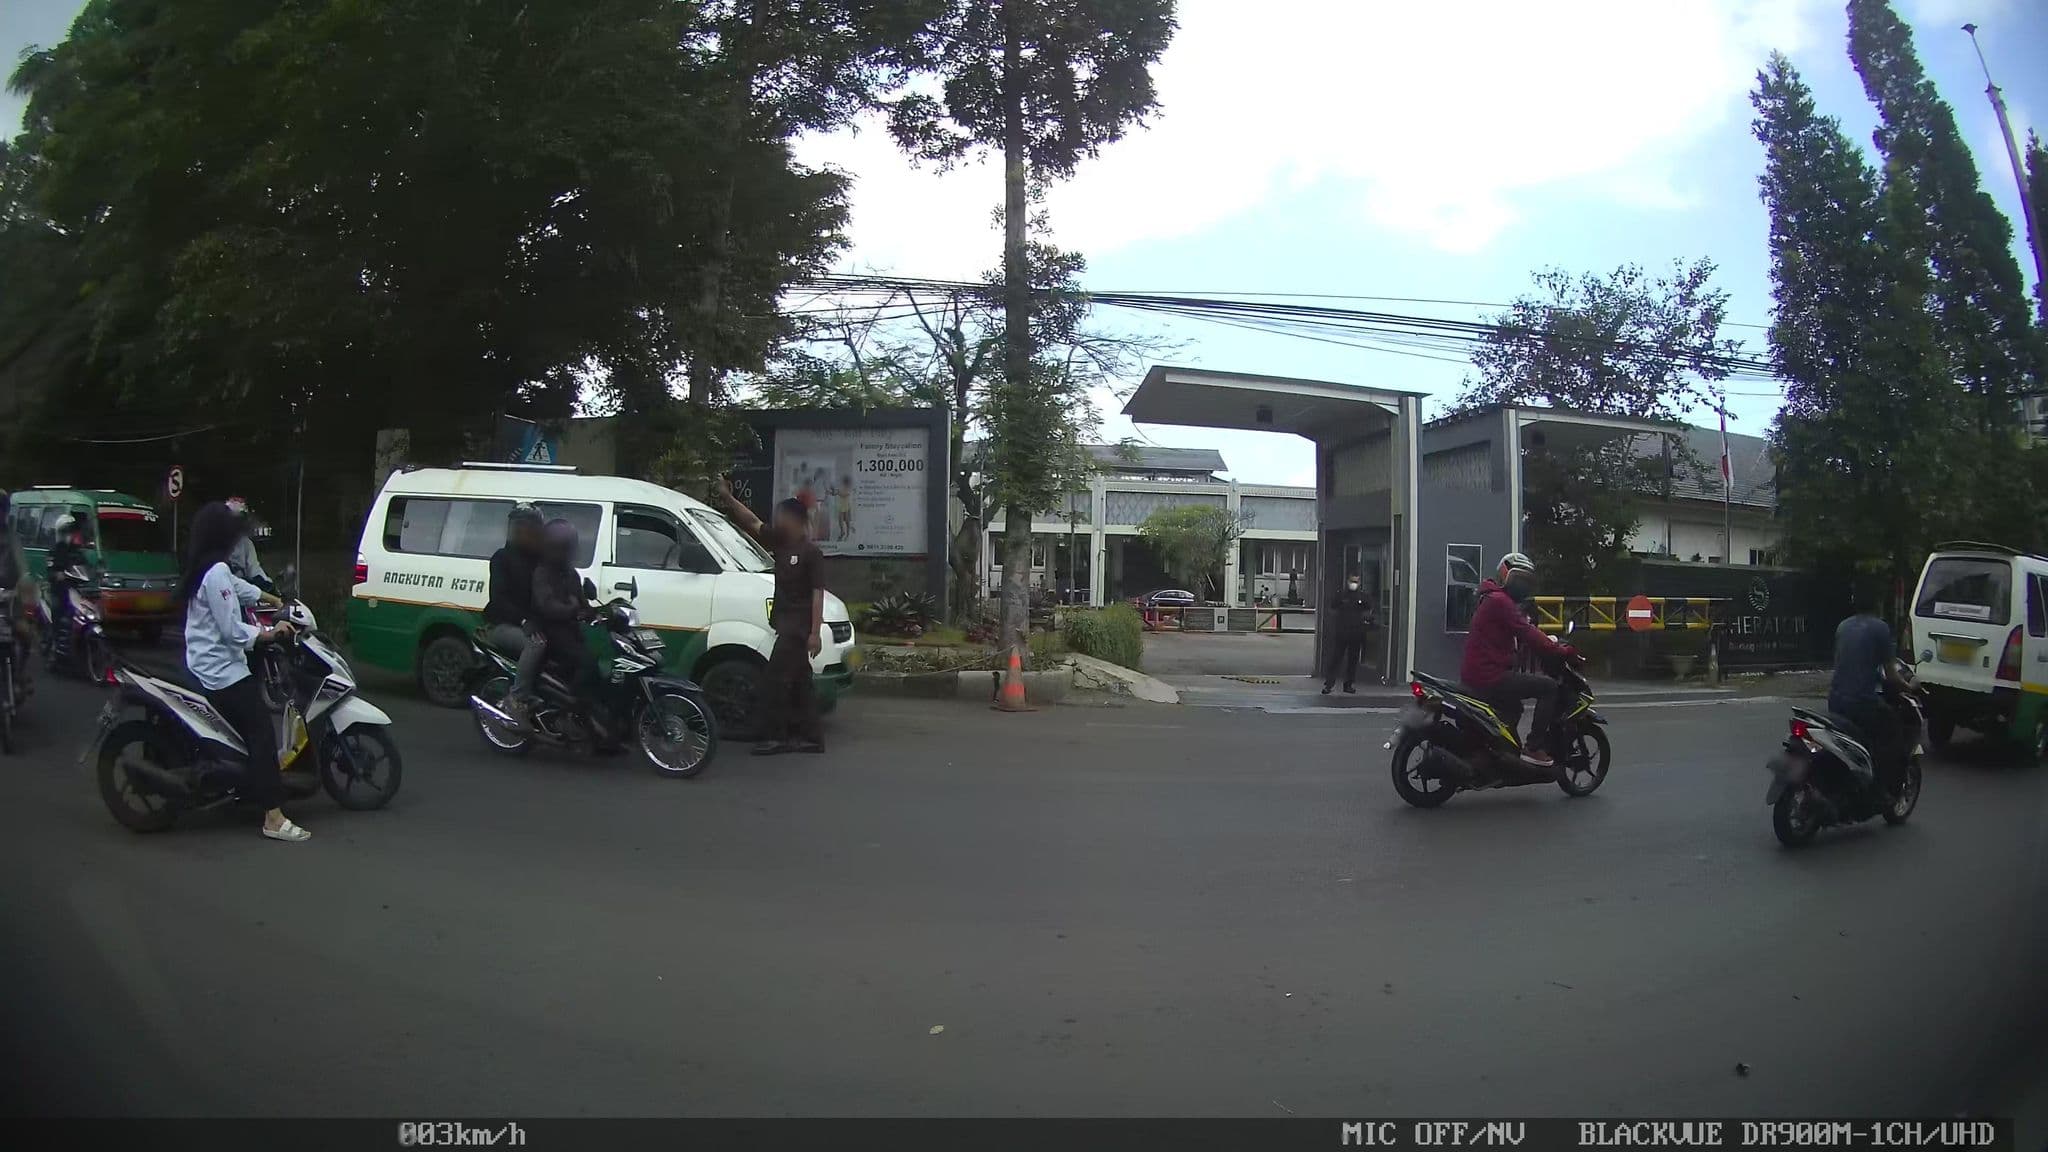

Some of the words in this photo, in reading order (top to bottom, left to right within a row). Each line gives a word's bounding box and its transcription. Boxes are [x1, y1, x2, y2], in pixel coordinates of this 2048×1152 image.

[857, 459, 924, 472] 1.300.000
[383, 571, 444, 589] ANGKUTAN
[450, 578, 485, 593] KOTA
